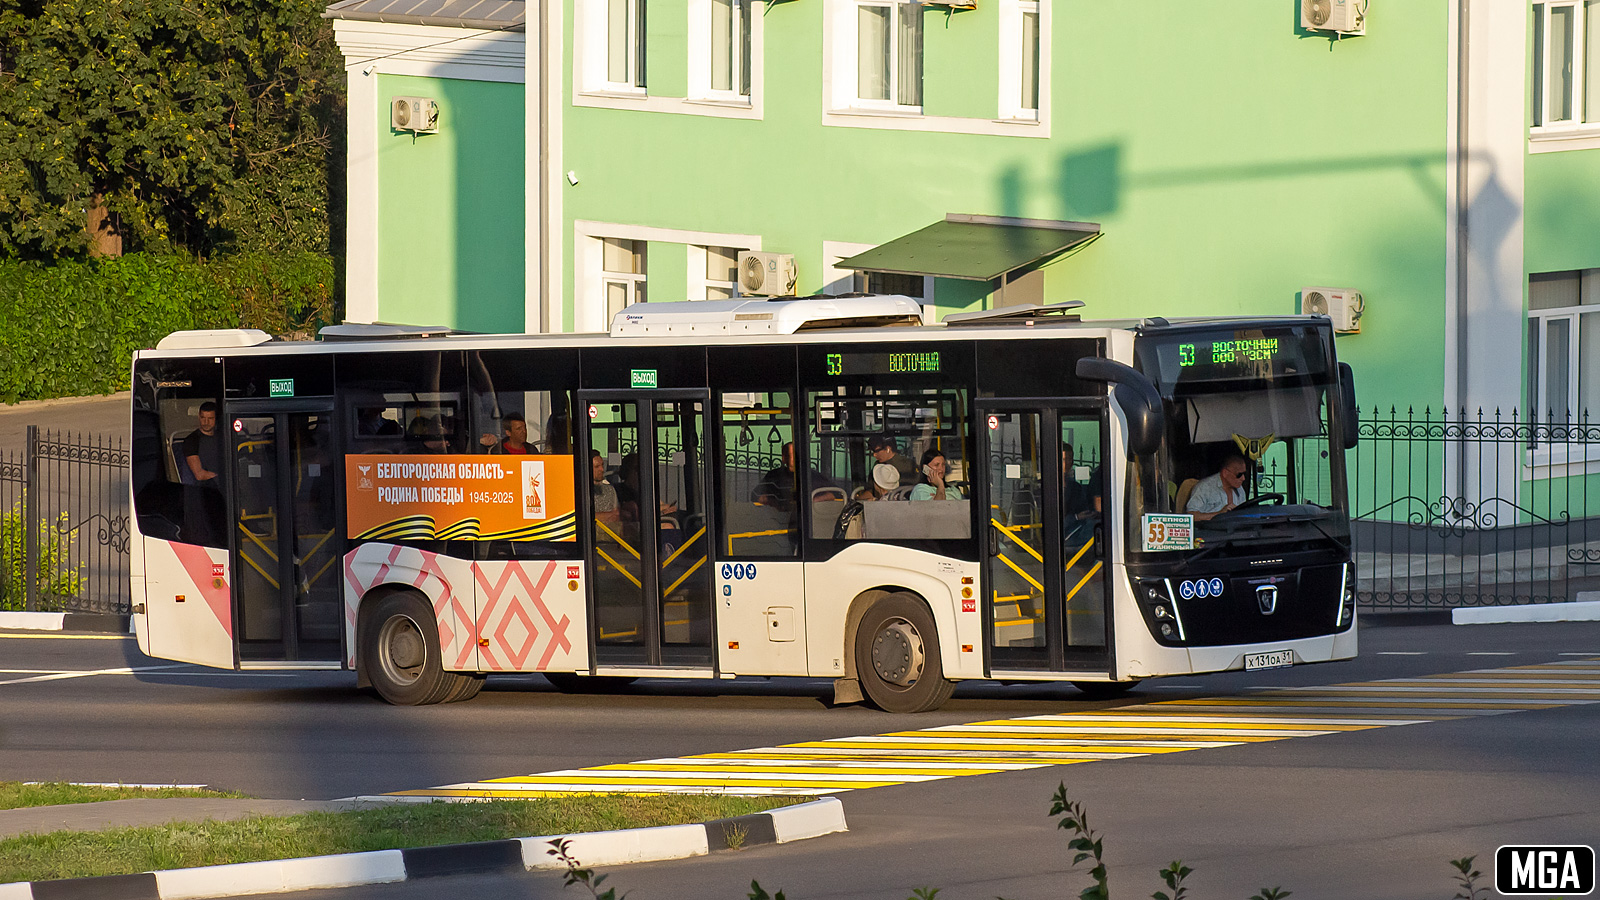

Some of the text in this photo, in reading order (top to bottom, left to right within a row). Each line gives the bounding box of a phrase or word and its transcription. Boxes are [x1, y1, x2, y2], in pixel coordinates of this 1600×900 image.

[1179, 338, 1278, 367] 53 ВОСТОЧНЫЙ
[827, 351, 939, 375] 53 ВОСТОЧНЫЙ
[271, 381, 293, 393] ВЫХОД
[632, 372, 655, 385] ВЫХОД
[377, 463, 456, 482] БЕЛГОРОДСКАЯ
[458, 463, 504, 480] ОБЛАСТЬ
[378, 486, 514, 505] РОДИНА ПОБЕДЫ 1945-2025
[1148, 523, 1165, 543] 53
